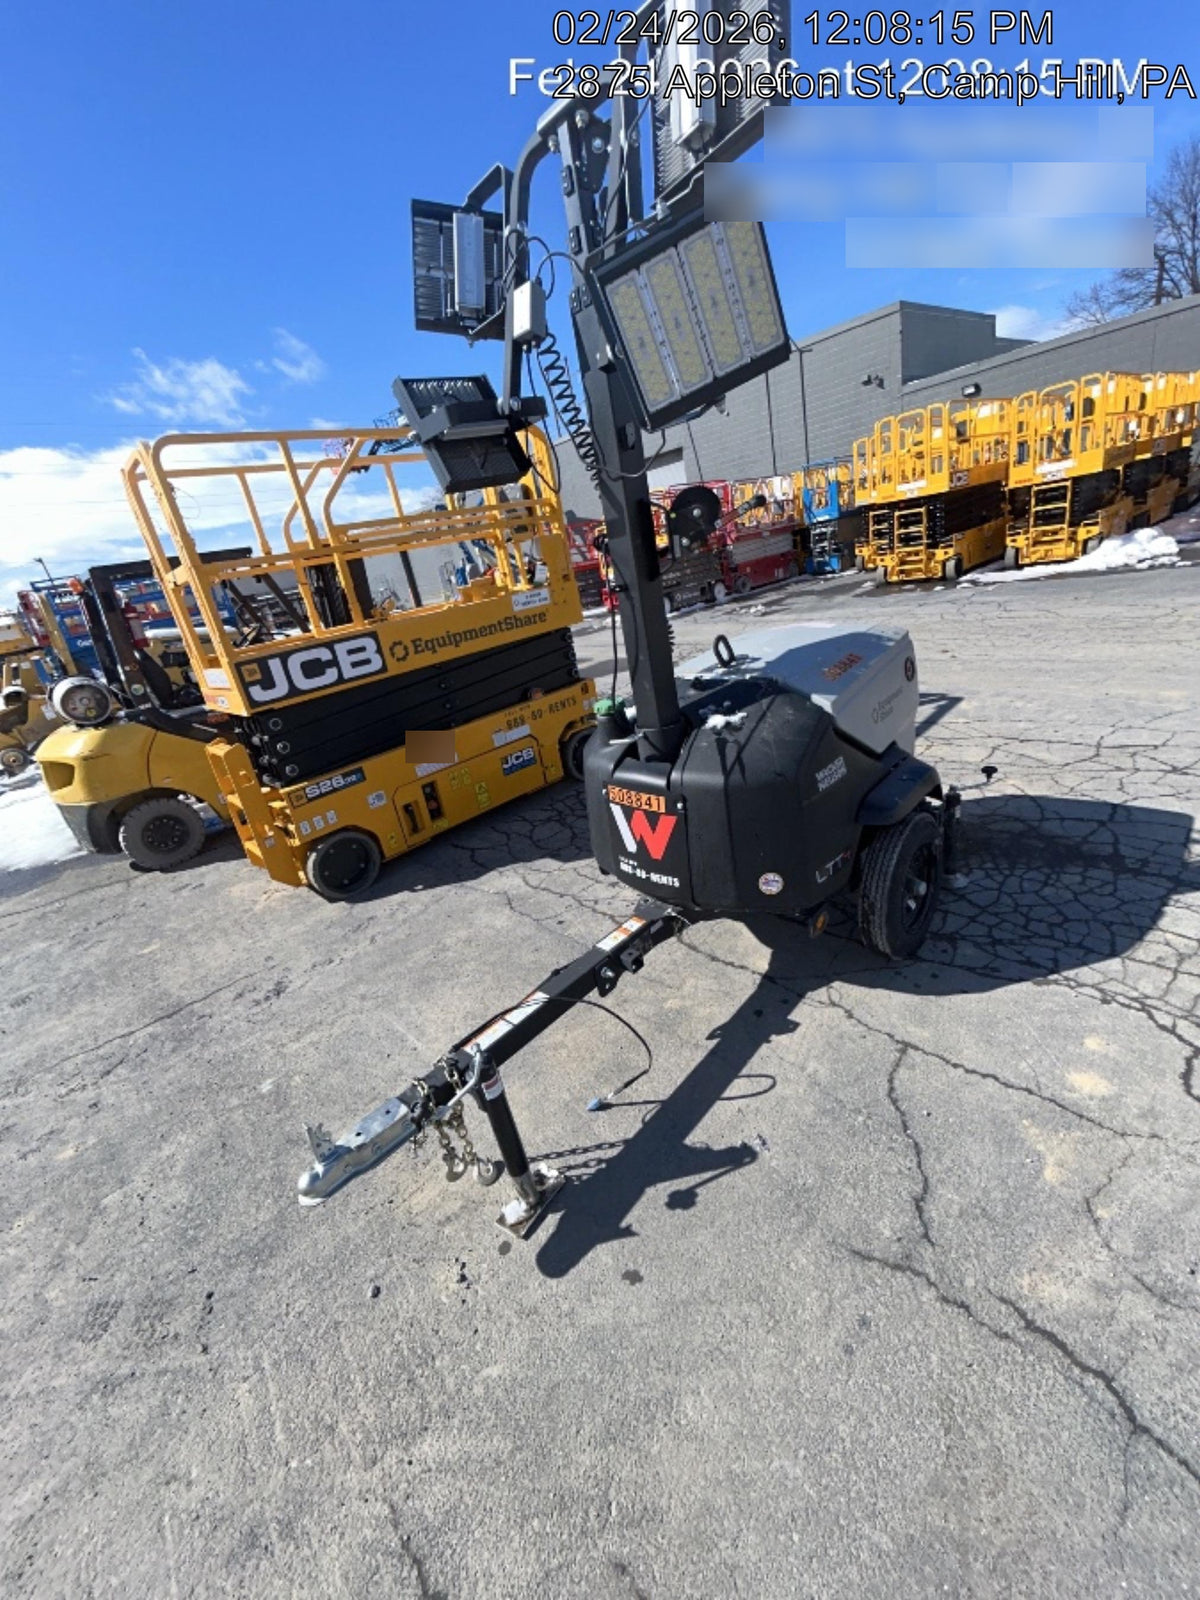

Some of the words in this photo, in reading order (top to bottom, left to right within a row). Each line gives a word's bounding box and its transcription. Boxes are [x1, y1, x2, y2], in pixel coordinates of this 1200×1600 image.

[411, 610, 547, 655] EquipmentShare
[248, 636, 383, 702] JCB
[502, 747, 535, 769] JCB
